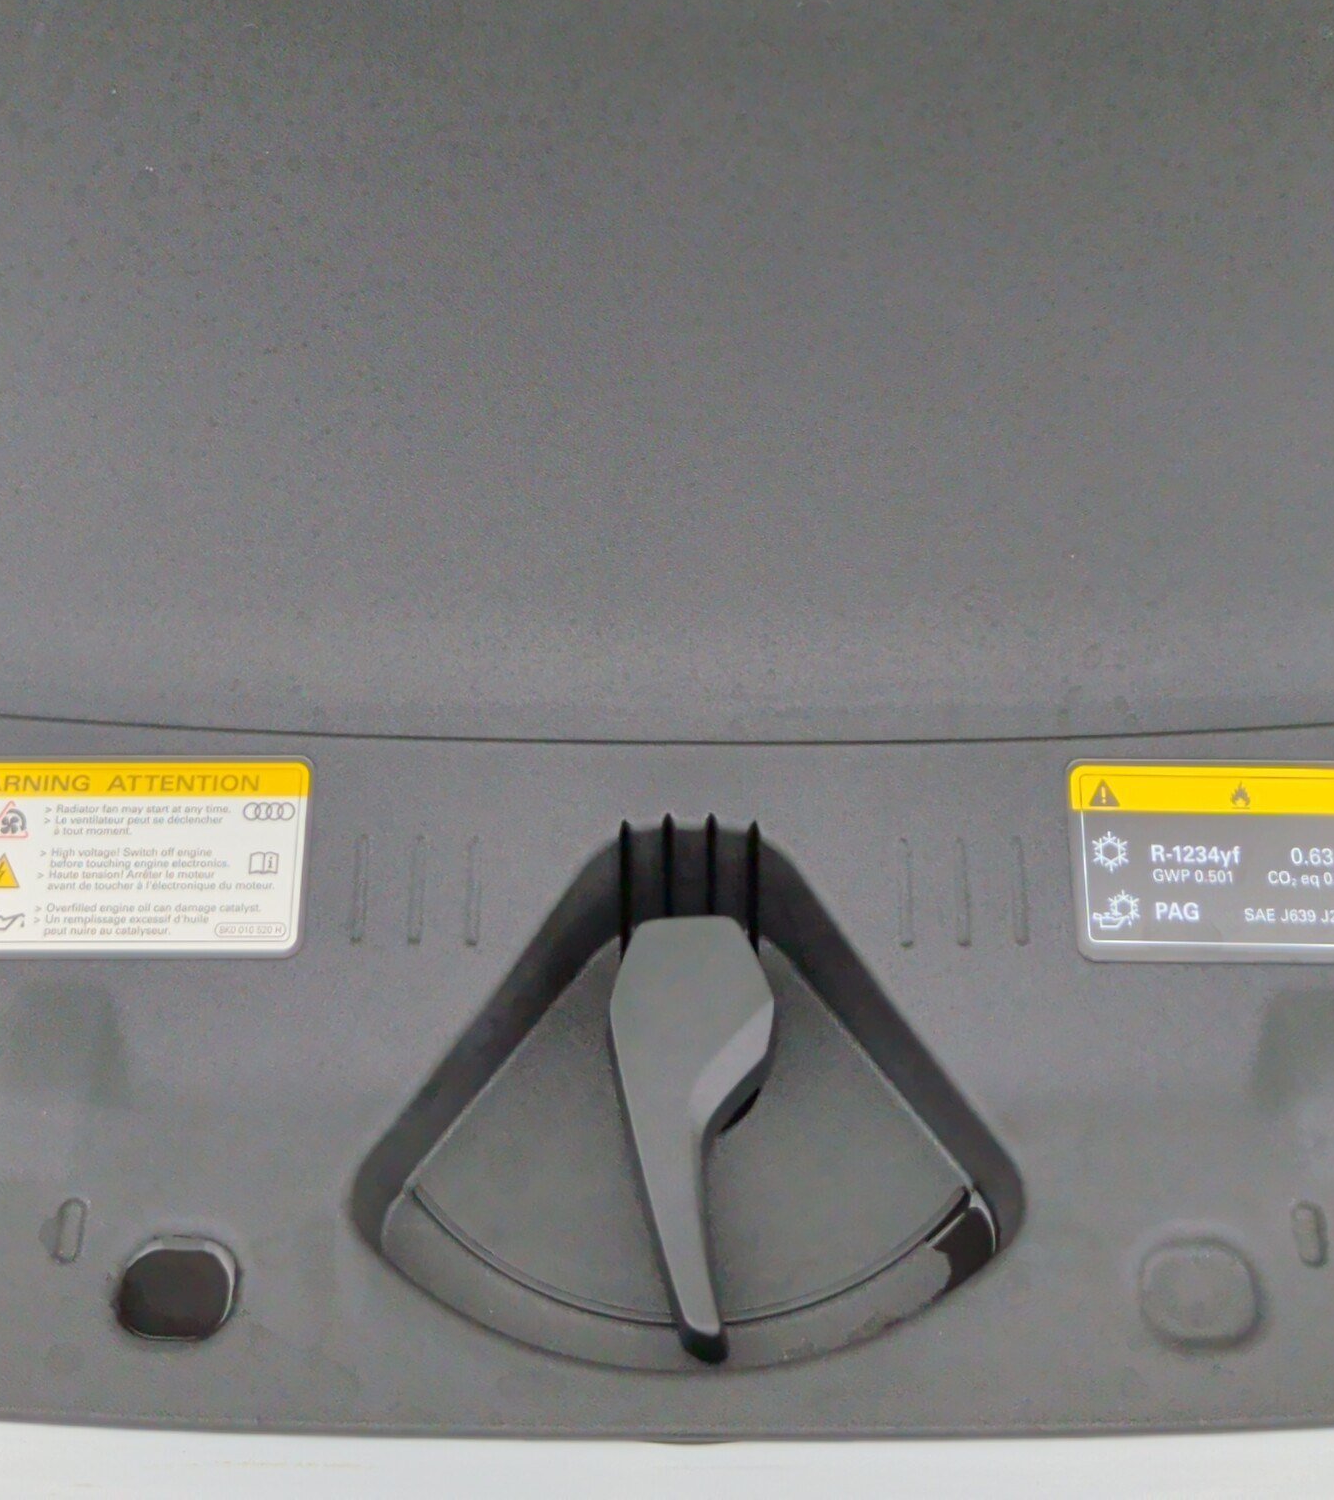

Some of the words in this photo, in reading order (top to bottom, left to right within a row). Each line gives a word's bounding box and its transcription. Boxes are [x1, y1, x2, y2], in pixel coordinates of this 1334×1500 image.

[106, 774, 260, 792] ATTENTION
[56, 804, 99, 814] Radiator
[102, 804, 119, 814] fan
[122, 806, 143, 816] may
[146, 804, 169, 814] start
[172, 804, 182, 814] at
[184, 806, 202, 816] any
[206, 804, 231, 814] time.
[55, 816, 68, 825] Le
[71, 816, 124, 825] ventilateur
[127, 816, 150, 826] peut
[168, 816, 223, 825] déclencher
[63, 826, 83, 835] tout
[86, 826, 132, 835] moment.
[51, 848, 75, 859] High
[78, 848, 120, 859] voltage!
[122, 848, 157, 857] Switch
[161, 848, 175, 857] off
[177, 849, 212, 859] engine
[1151, 844, 1242, 868] R-1234yf
[50, 859, 83, 868] before
[86, 860, 131, 870] touching
[134, 860, 169, 870] engine
[172, 860, 230, 868] electronics.
[49, 870, 79, 879] Haute
[82, 870, 123, 879] tension!
[126, 870, 162, 879] Arrêter
[165, 870, 174, 879] le
[177, 870, 214, 879] moteur
[1153, 869, 1190, 883] GWP
[1195, 869, 1233, 883] 0.501
[47, 881, 76, 890] avant
[79, 881, 92, 890] de
[94, 881, 133, 890] toucher
[146, 880, 216, 892] l'électronique
[219, 881, 232, 890] du
[236, 881, 275, 890] moteur.
[1301, 874, 1320, 888] eq
[46, 903, 96, 913] Overfilled
[100, 904, 135, 914] engine
[138, 903, 150, 913] oil
[175, 904, 216, 914] damage
[219, 904, 261, 914] catalyst.
[1155, 902, 1199, 920] PAG
[45, 915, 60, 924] Un
[64, 915, 126, 925] remplissage
[129, 915, 171, 924] excessif
[174, 915, 209, 924] d'huile
[1244, 908, 1276, 921] SAE
[1281, 908, 1316, 922] J639
[44, 927, 67, 937] peut
[70, 926, 96, 935] nuire
[115, 926, 171, 937] catalyseur.
